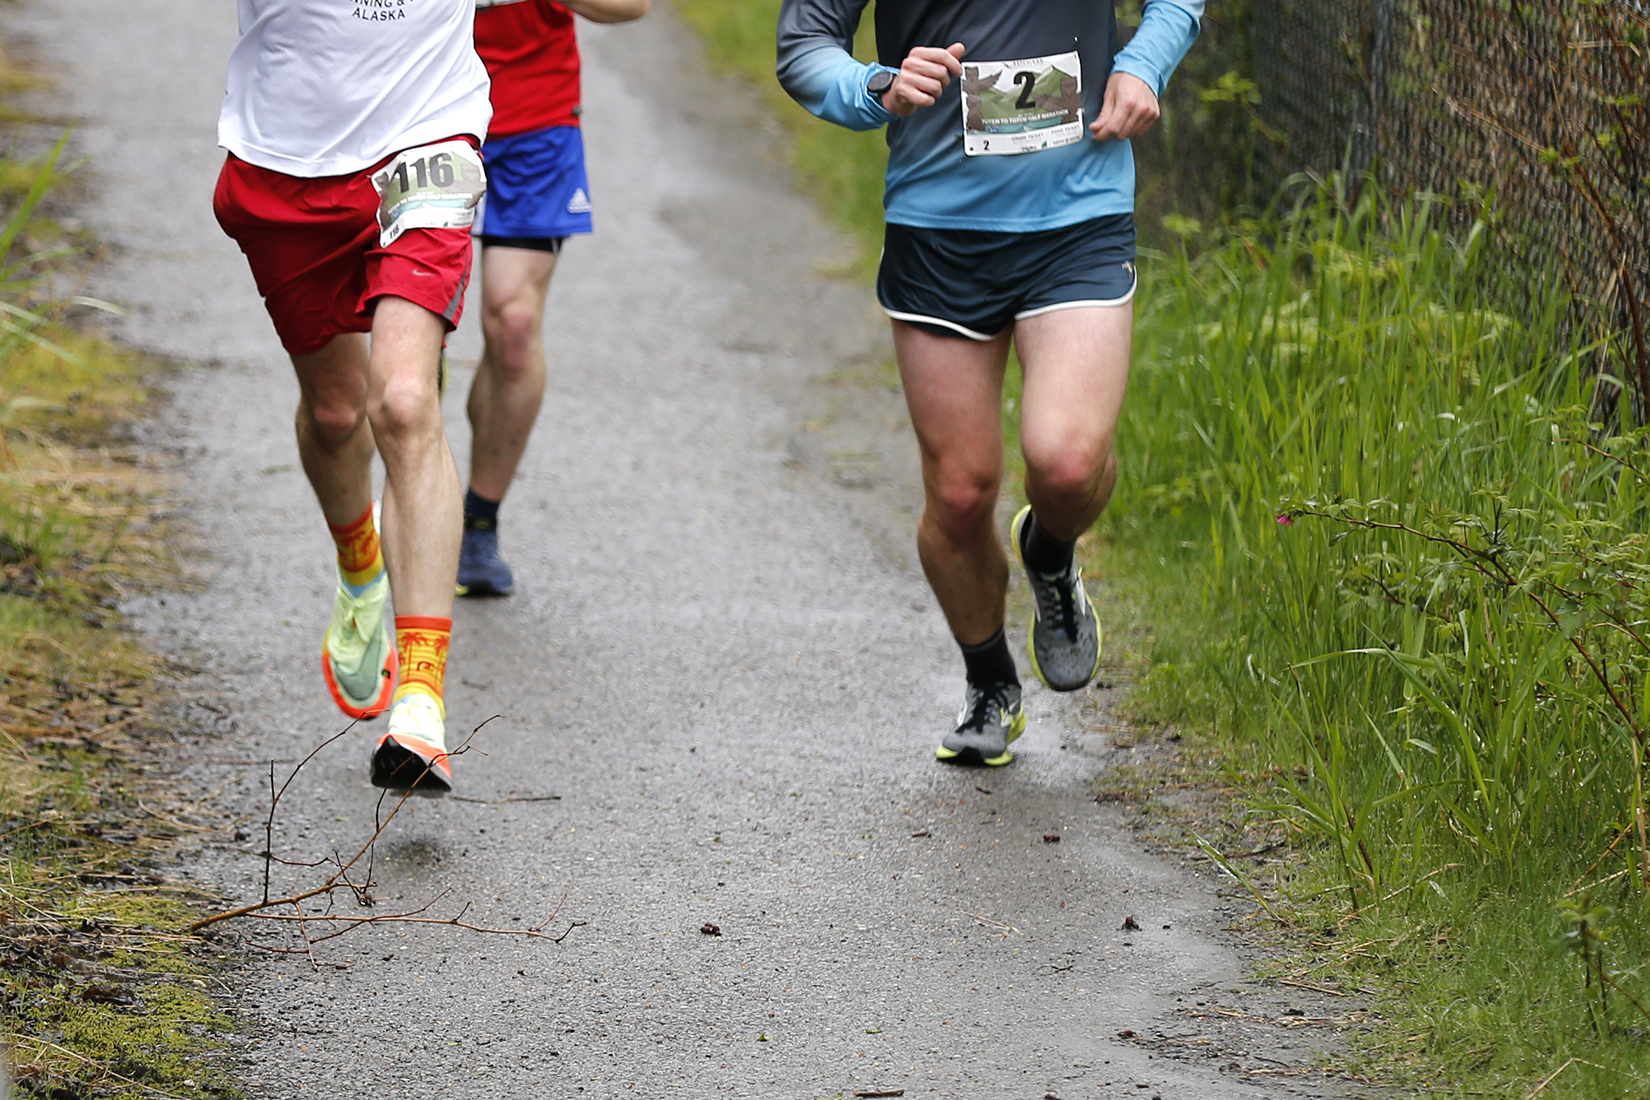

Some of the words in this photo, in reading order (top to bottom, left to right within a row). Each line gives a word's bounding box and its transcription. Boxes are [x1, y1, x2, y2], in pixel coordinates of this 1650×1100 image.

[352, 7, 406, 21] ALASKA
[1013, 71, 1036, 109] 2
[983, 140, 990, 151] 2
[394, 152, 454, 193] 116
